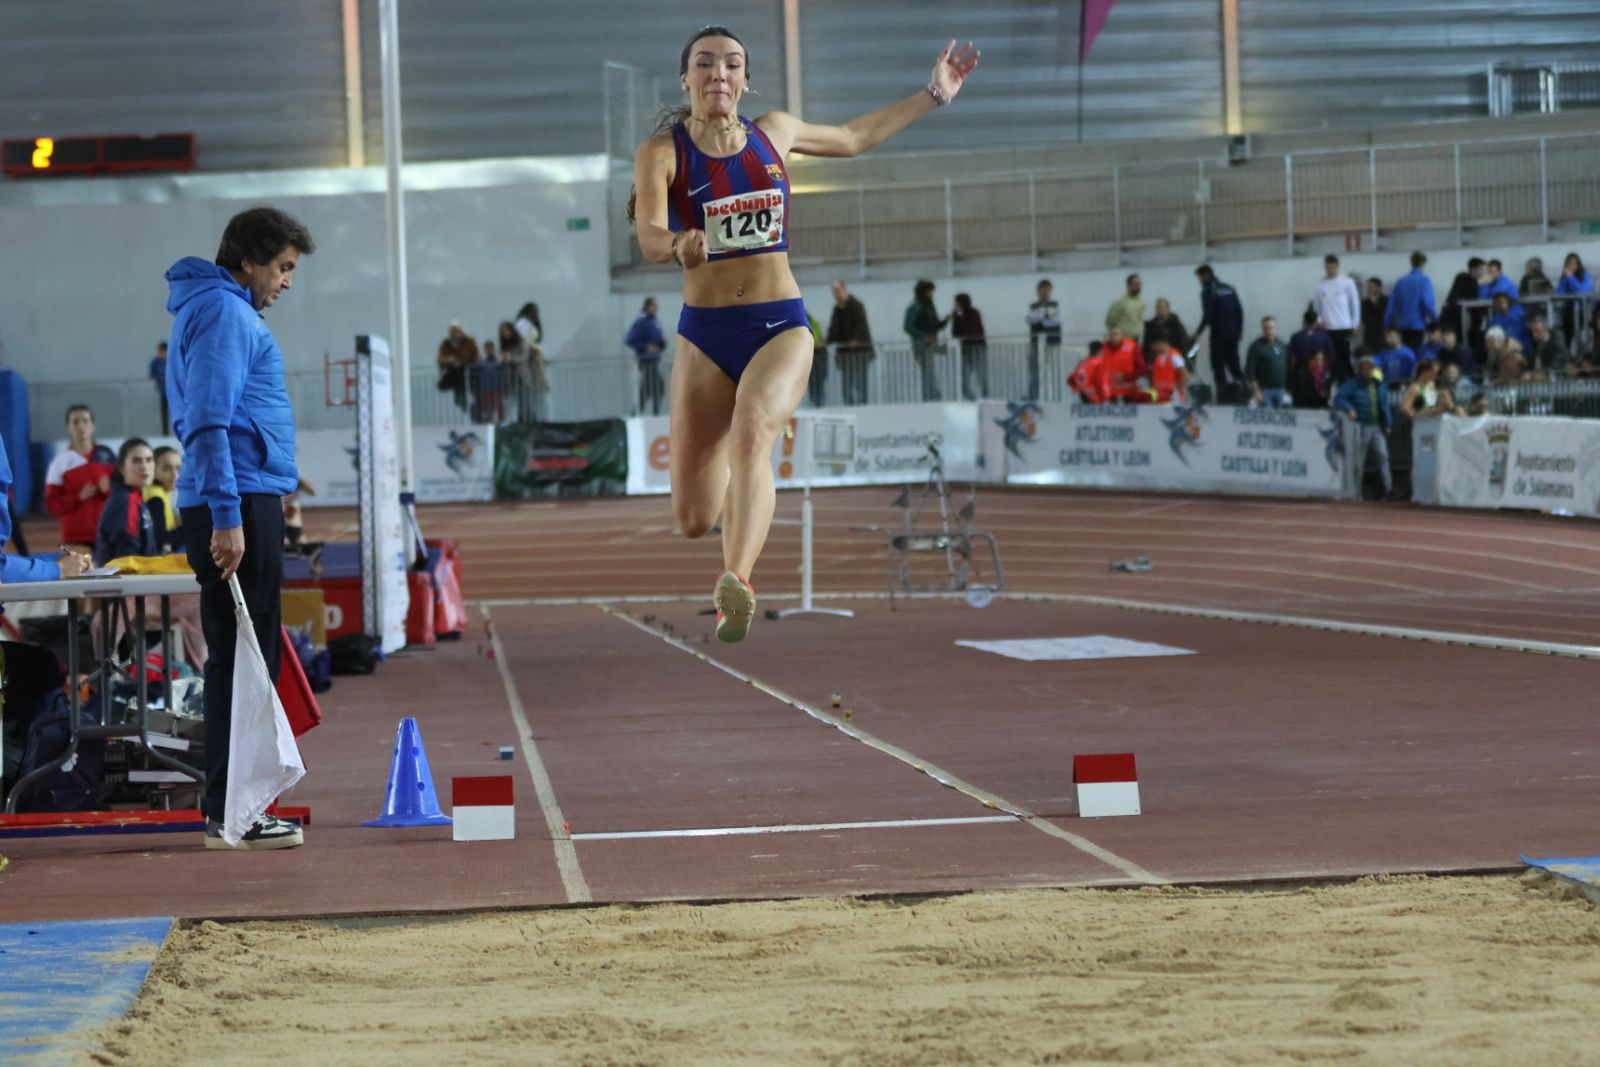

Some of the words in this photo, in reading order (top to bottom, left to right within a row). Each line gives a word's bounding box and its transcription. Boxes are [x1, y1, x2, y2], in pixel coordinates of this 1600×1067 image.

[32, 137, 54, 168] 2
[721, 208, 772, 239] 120
[1059, 448, 1110, 466] CASTILLA
[1112, 449, 1120, 465] Y
[1221, 454, 1269, 474] CASTILLA
[1271, 459, 1279, 475] Y
